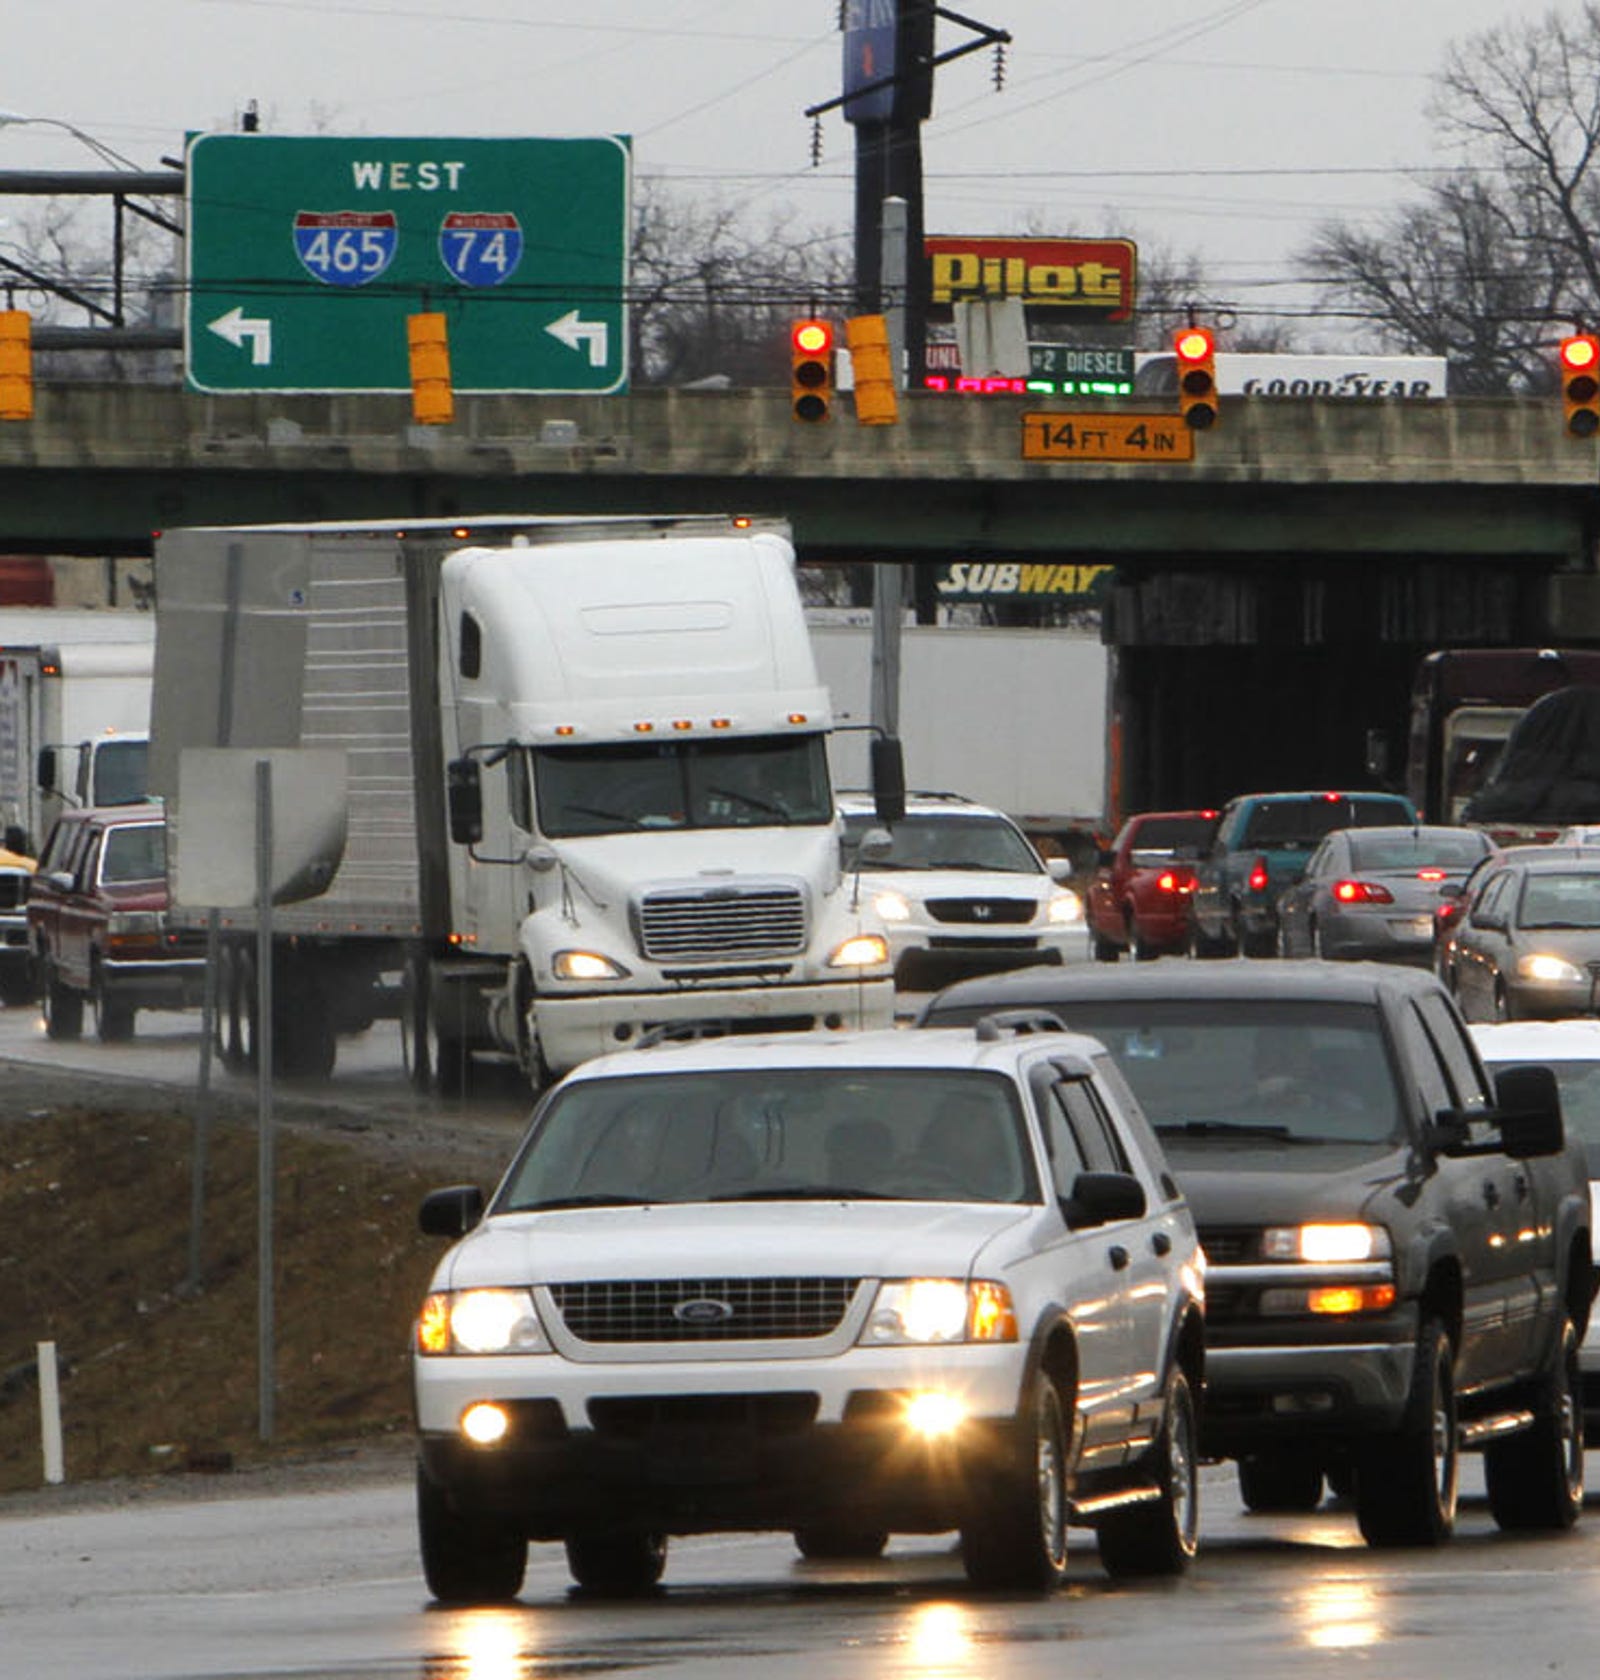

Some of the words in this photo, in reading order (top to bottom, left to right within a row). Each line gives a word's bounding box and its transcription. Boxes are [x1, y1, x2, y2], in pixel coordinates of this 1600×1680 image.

[352, 161, 465, 191] WEST
[303, 231, 386, 272] 465
[452, 232, 508, 273] 74
[933, 254, 1121, 303] Pilot
[1032, 350, 1056, 372] #2
[1066, 352, 1127, 374] DIESEL
[1243, 377, 1431, 397] GOODYEAR
[936, 562, 1115, 594] SUBWAY
